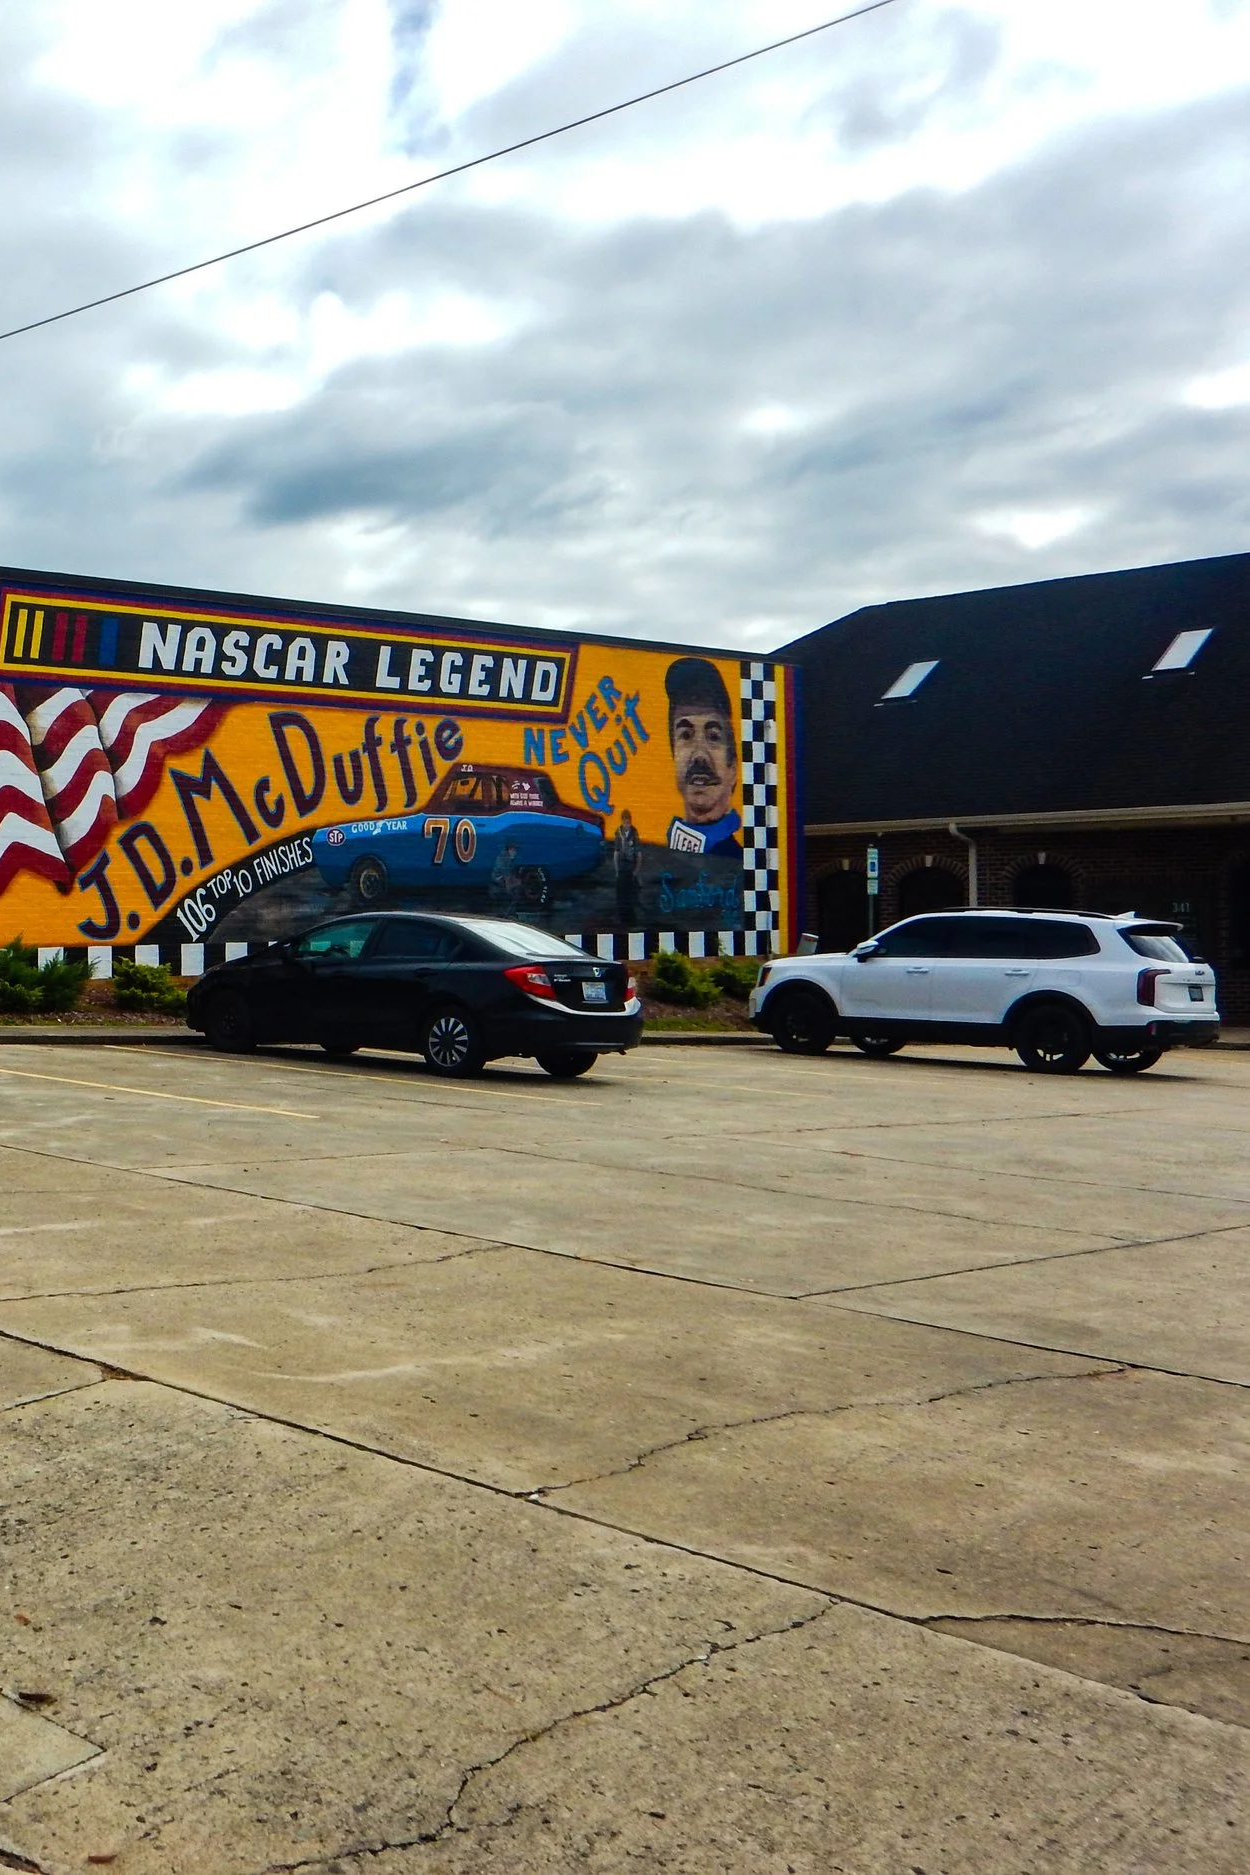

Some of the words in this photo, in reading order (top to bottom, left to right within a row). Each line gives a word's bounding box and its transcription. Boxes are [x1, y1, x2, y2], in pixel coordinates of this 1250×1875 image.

[138, 621, 350, 686] NASCAR
[376, 645, 558, 702] LEGEND
[523, 675, 623, 766] NEVER
[77, 820, 195, 941] J.D.
[168, 711, 464, 871] McDuffie
[351, 822, 373, 834] GOOD
[386, 820, 408, 831] YEAR
[423, 817, 477, 864] 70
[176, 888, 216, 942] 106
[206, 869, 233, 899] TOP
[233, 869, 253, 898] 10
[253, 837, 313, 886] FINISHES
